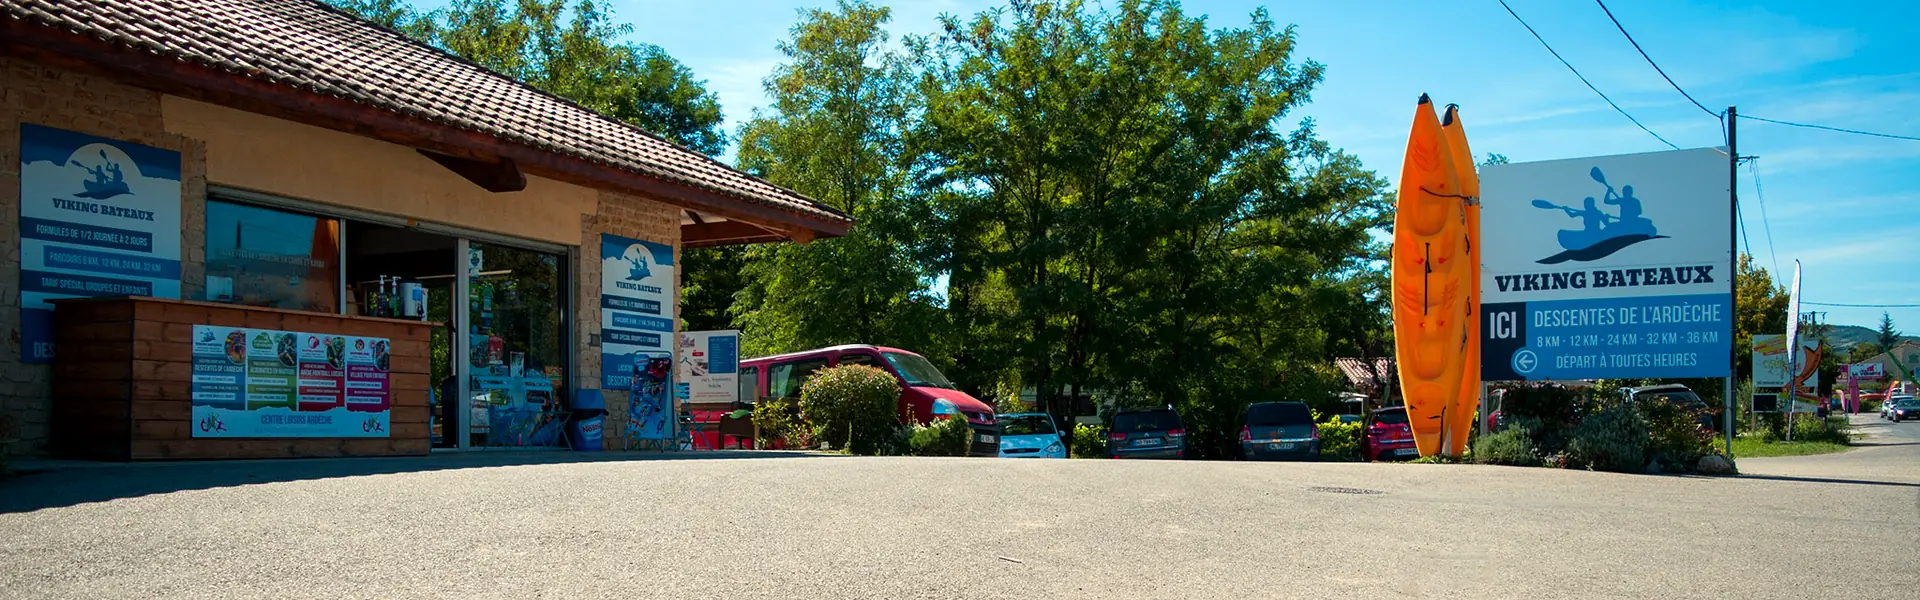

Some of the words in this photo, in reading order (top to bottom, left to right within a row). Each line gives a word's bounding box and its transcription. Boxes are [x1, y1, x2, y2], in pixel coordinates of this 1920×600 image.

[52, 198, 98, 214] VIKING
[100, 204, 154, 222] BATEAUX
[36, 224, 70, 238] FORMULES
[70, 228, 78, 238] DE
[80, 229, 92, 240] 1/2
[93, 230, 118, 243] JOURNÉE
[120, 233, 124, 244] À
[125, 235, 129, 245] 2
[130, 236, 148, 247] JOURS
[49, 251, 82, 264] PARCOURS
[102, 258, 109, 267] 12
[122, 260, 130, 269] 24
[143, 262, 151, 271] 32
[152, 263, 161, 273] KM
[41, 277, 59, 288] TARIF
[60, 278, 85, 290] SPÉCIAL
[86, 281, 113, 292] GROUPES
[113, 284, 121, 293] ET
[122, 285, 148, 296] ENFANTS
[616, 281, 636, 290] VIKING
[638, 284, 662, 294] BATEAUX
[1494, 271, 1586, 292] VIKING
[1592, 266, 1714, 288] BATEAUX
[1535, 308, 1615, 327] DESCENTES
[1620, 307, 1638, 324] DE
[1642, 301, 1721, 324] L'ARDÈCHE
[1490, 312, 1517, 339] ICI
[1537, 336, 1543, 347] 8
[1545, 336, 1560, 347] KM
[1570, 335, 1580, 346] 12
[1583, 335, 1598, 346] KM
[1607, 334, 1620, 345] 24
[1622, 334, 1637, 345] KM
[1646, 333, 1659, 344] 32
[1662, 332, 1677, 344] KM
[1687, 332, 1699, 343] 36
[1702, 331, 1718, 343] KM
[1556, 352, 1596, 369] DÉPART
[1600, 351, 1607, 367] À
[1609, 354, 1650, 367] TOUTES
[1654, 353, 1697, 366] HEURES
[261, 415, 284, 424] CENTRE
[285, 415, 306, 424] LOISIRS
[307, 414, 332, 424] ARDÈCHE
